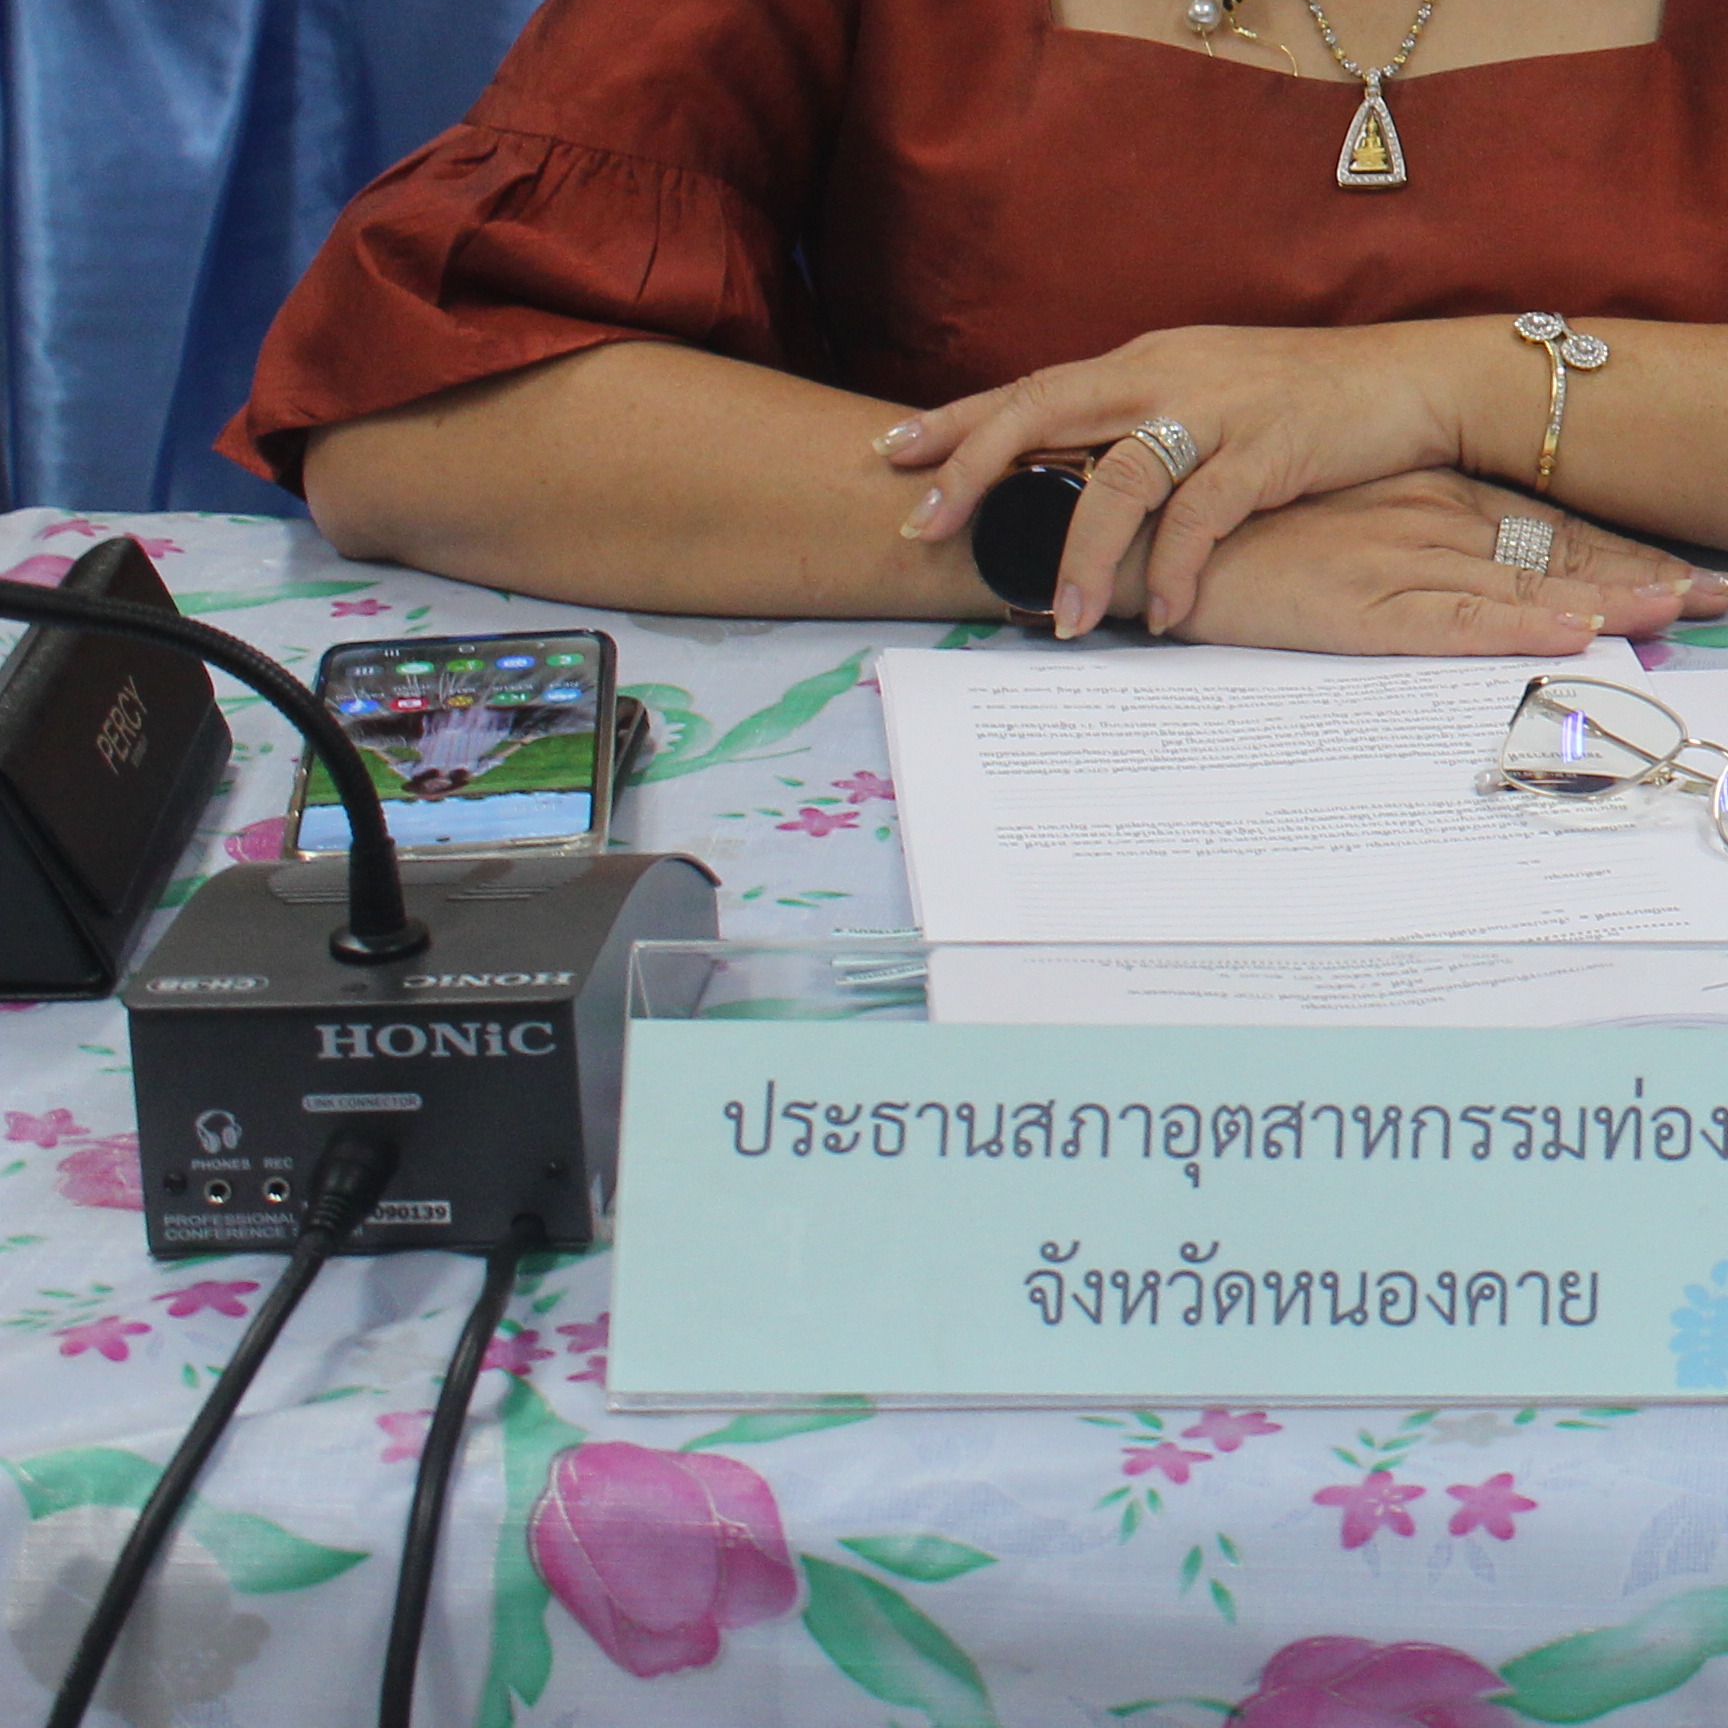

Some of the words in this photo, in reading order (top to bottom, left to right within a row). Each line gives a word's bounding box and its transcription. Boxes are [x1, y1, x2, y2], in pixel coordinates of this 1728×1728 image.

[96, 675, 147, 775] PERCY
[191, 1158, 251, 1170] PHONES
[263, 1157, 294, 1169] REC
[1022, 1239, 1600, 1329] จังหวัดหนองคาย
